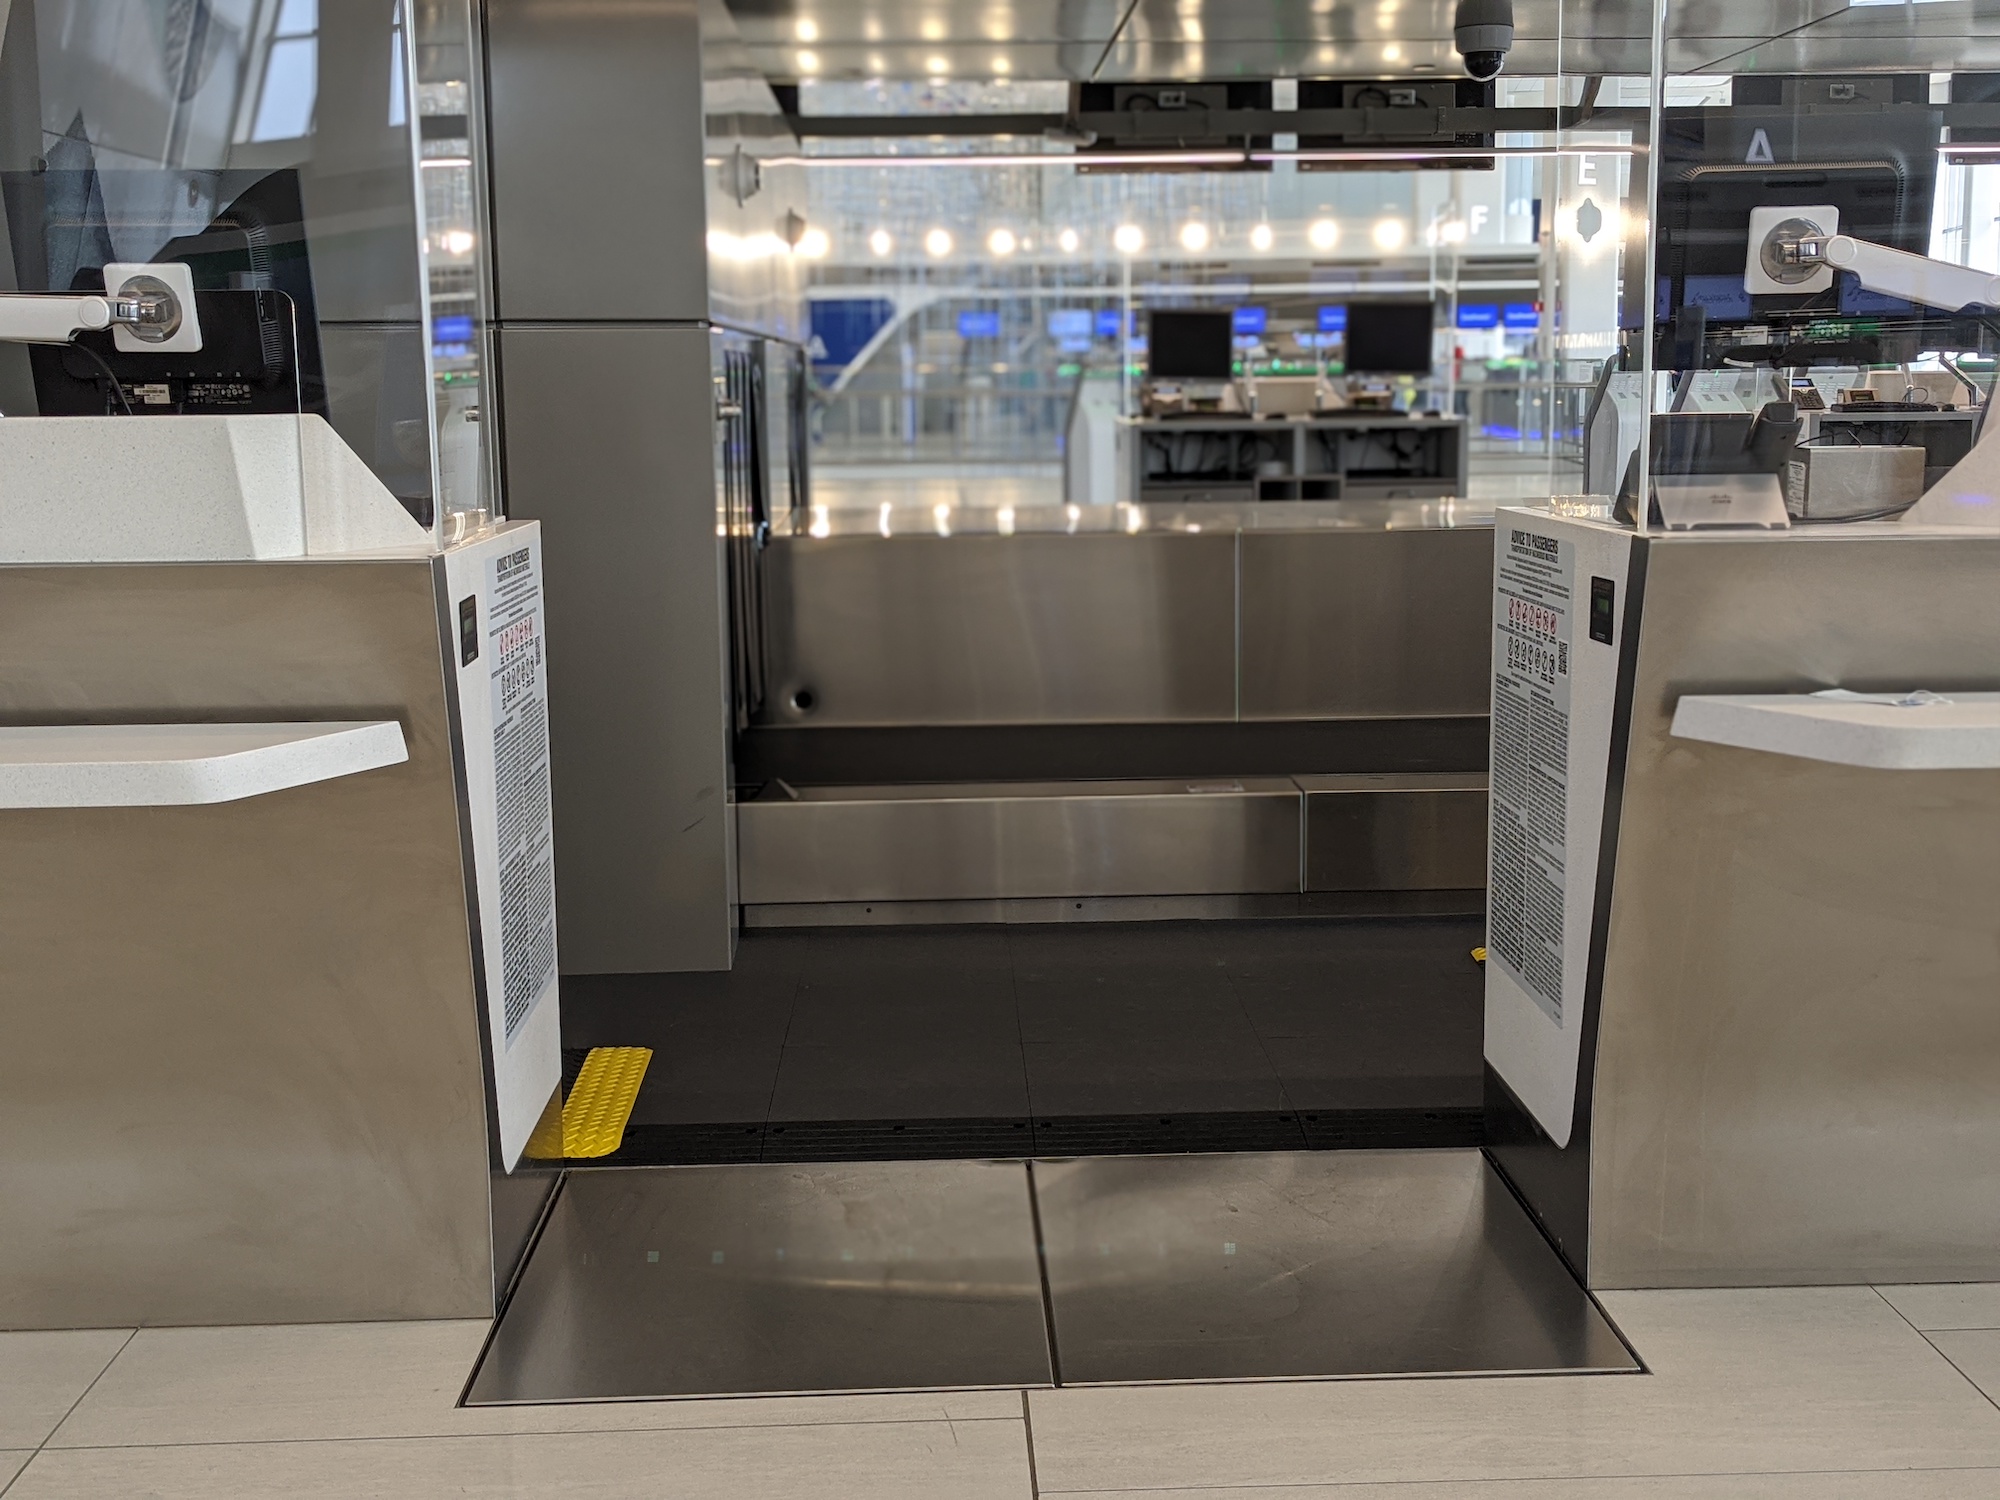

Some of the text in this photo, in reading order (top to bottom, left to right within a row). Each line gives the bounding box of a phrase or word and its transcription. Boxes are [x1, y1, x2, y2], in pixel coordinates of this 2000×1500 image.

[1578, 153, 1597, 185] E
[1470, 204, 1489, 235] F
[1511, 529, 1526, 546] ADVICE
[1532, 534, 1559, 555] PASSENGERS
